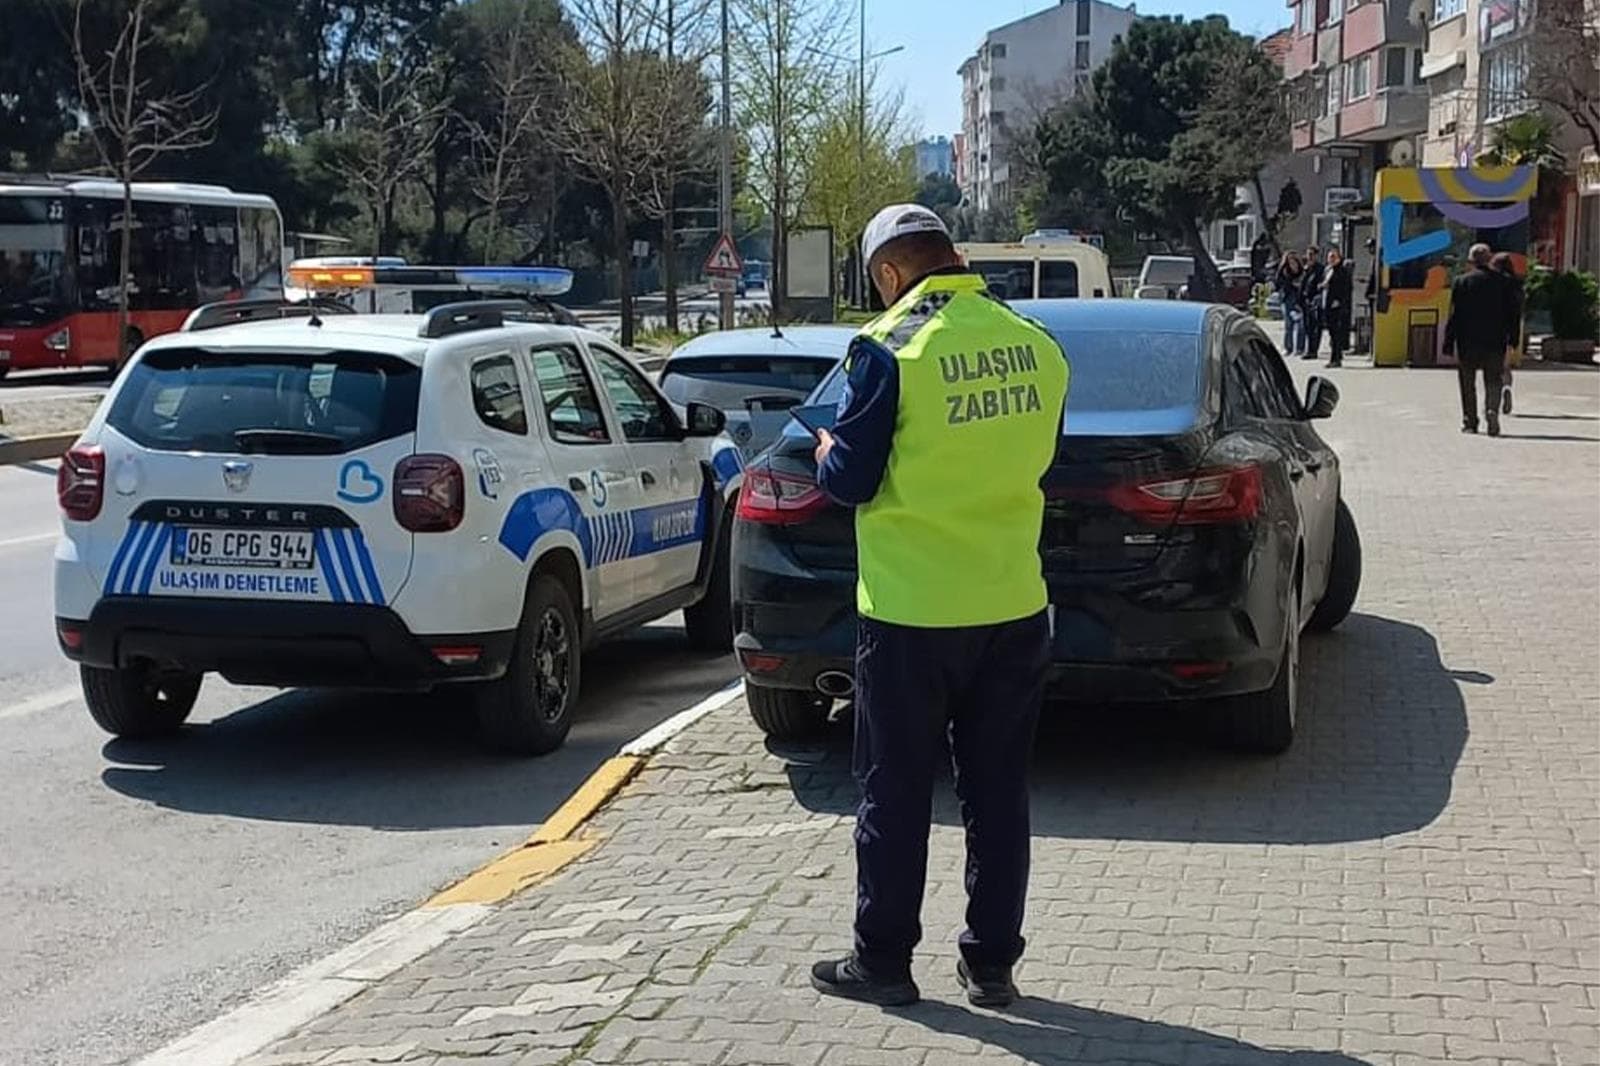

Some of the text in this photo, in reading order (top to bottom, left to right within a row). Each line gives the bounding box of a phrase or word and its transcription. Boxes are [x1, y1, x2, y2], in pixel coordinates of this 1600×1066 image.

[939, 344, 1038, 383] ULAŞIM
[946, 384, 1041, 425] ZABITA
[166, 506, 306, 521] DUSTER
[188, 532, 212, 555] 06
[223, 533, 261, 557] CPG
[269, 535, 307, 558] 944
[160, 570, 319, 594] ULAŞIM DENETLEME
